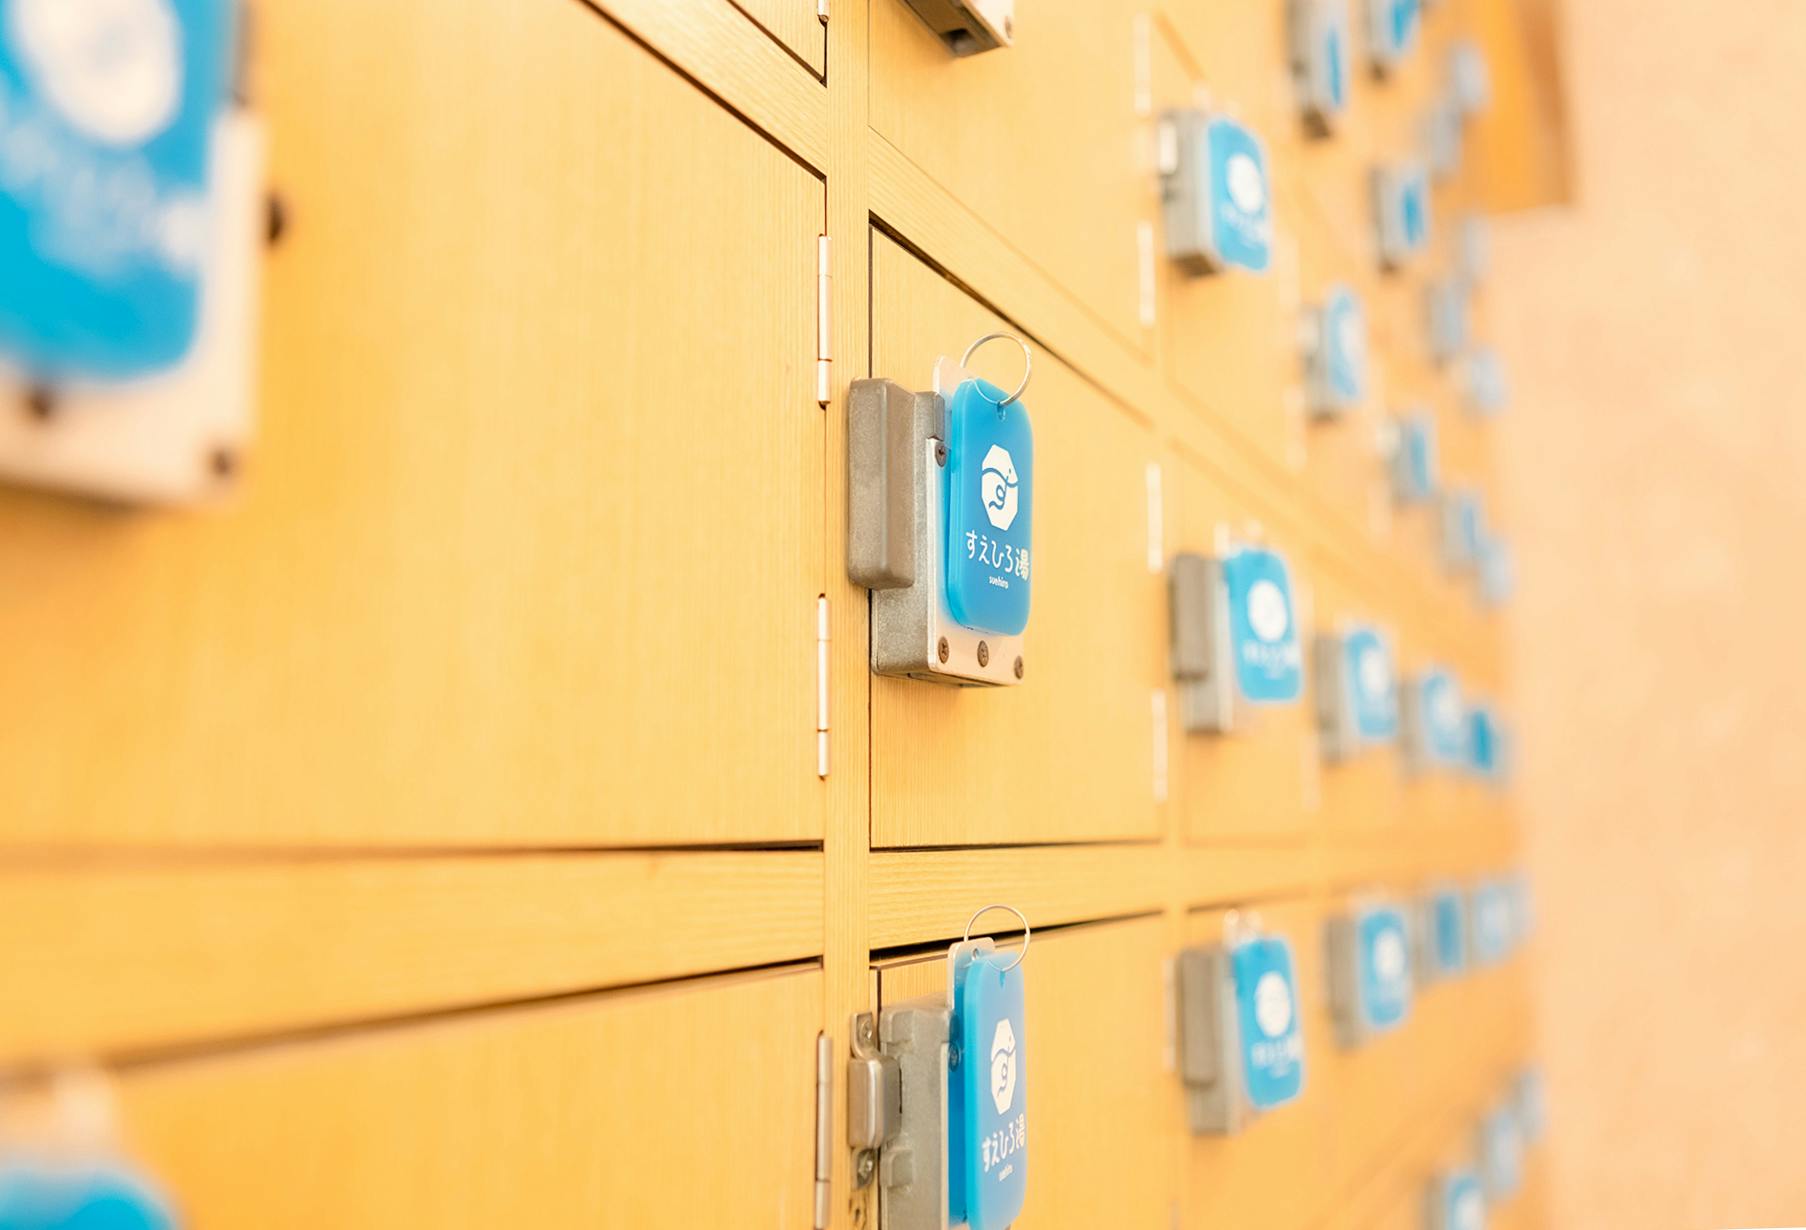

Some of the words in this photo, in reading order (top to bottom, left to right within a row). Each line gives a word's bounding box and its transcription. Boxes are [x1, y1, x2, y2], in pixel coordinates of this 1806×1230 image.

[966, 529, 1029, 581] すえひろ湯
